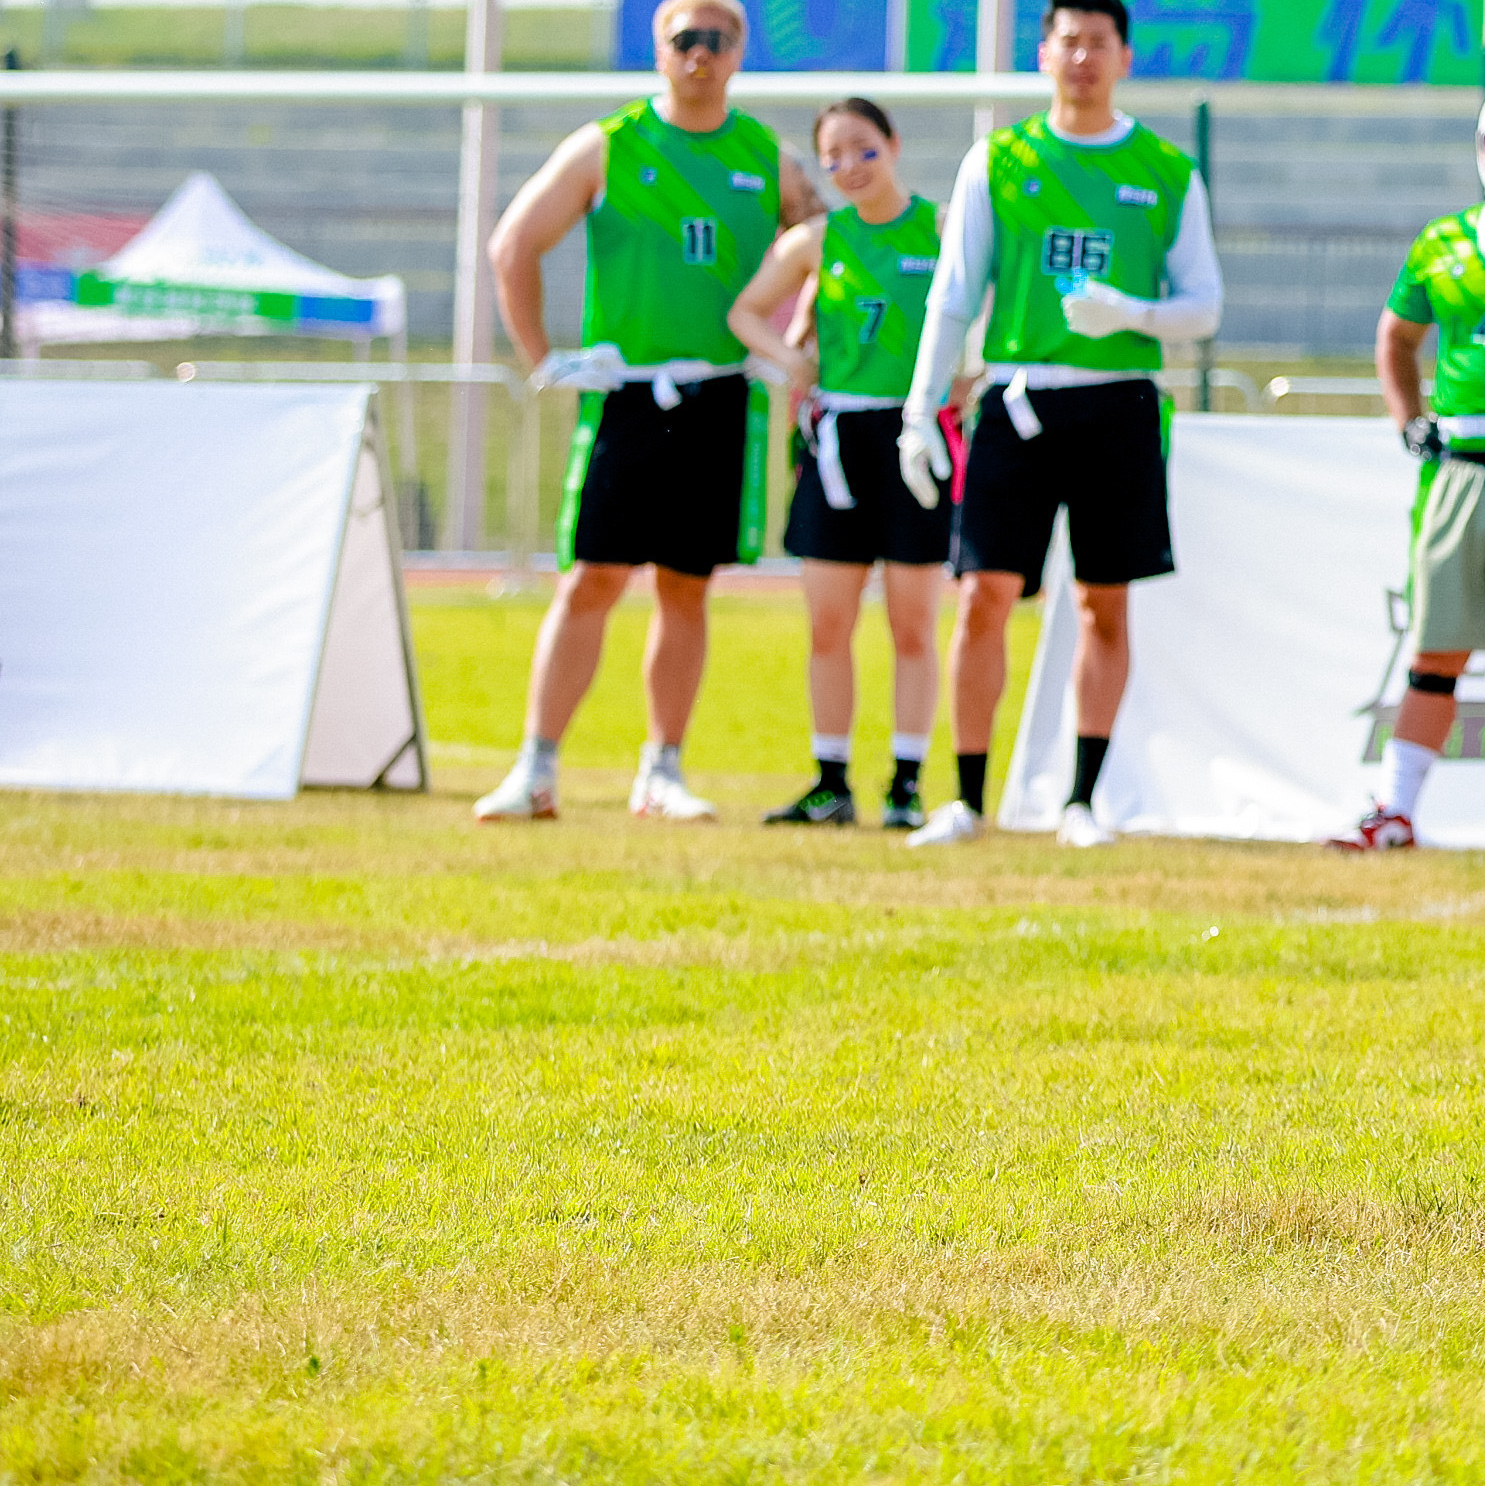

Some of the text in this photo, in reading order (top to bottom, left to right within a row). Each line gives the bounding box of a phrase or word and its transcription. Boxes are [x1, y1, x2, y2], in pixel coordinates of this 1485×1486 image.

[682, 217, 718, 265] 11
[1043, 226, 1115, 276] 86
[856, 296, 889, 345] 7
